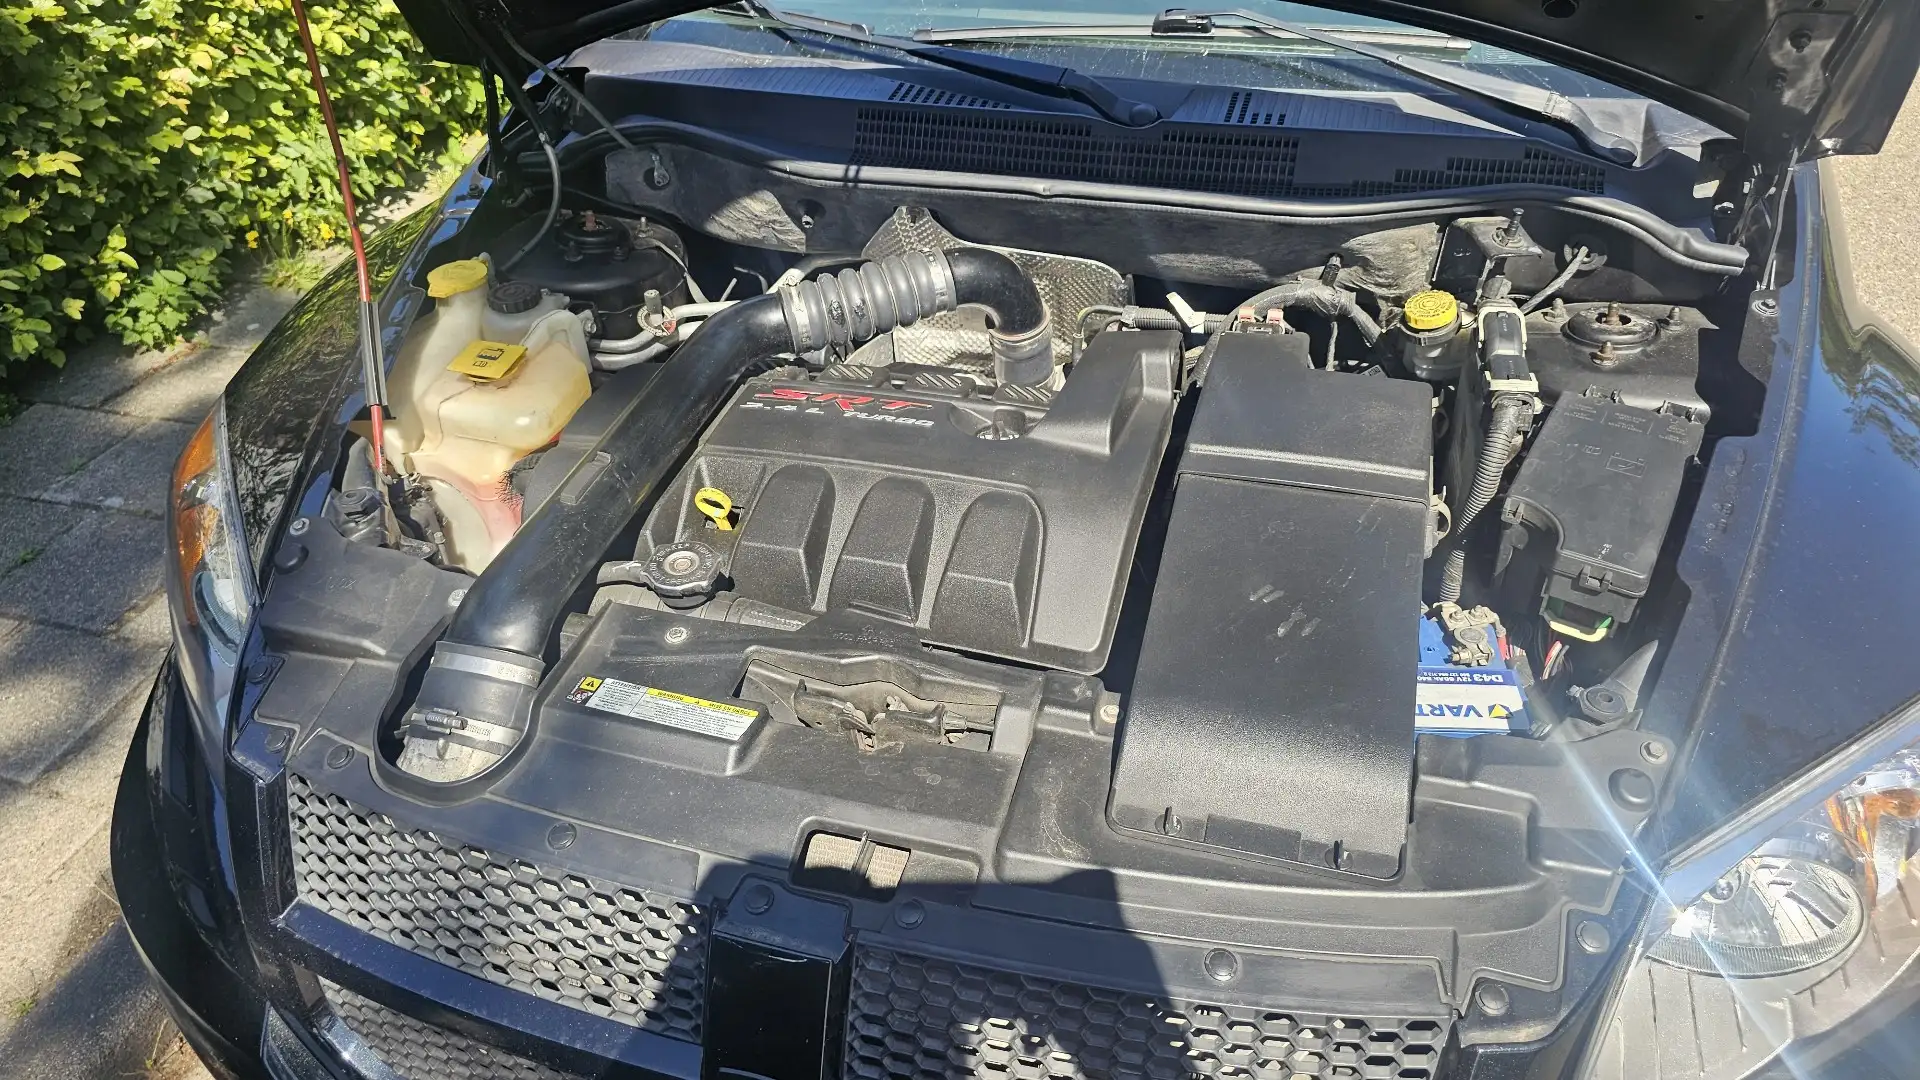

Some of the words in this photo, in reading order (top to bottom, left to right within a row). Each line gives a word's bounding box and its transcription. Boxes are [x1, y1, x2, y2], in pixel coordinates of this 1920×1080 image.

[753, 389, 932, 411] SRT
[843, 411, 935, 427] TURBO
[1473, 674, 1504, 682] D43
[610, 680, 642, 691] ATTENTION
[657, 691, 685, 701] WARNING
